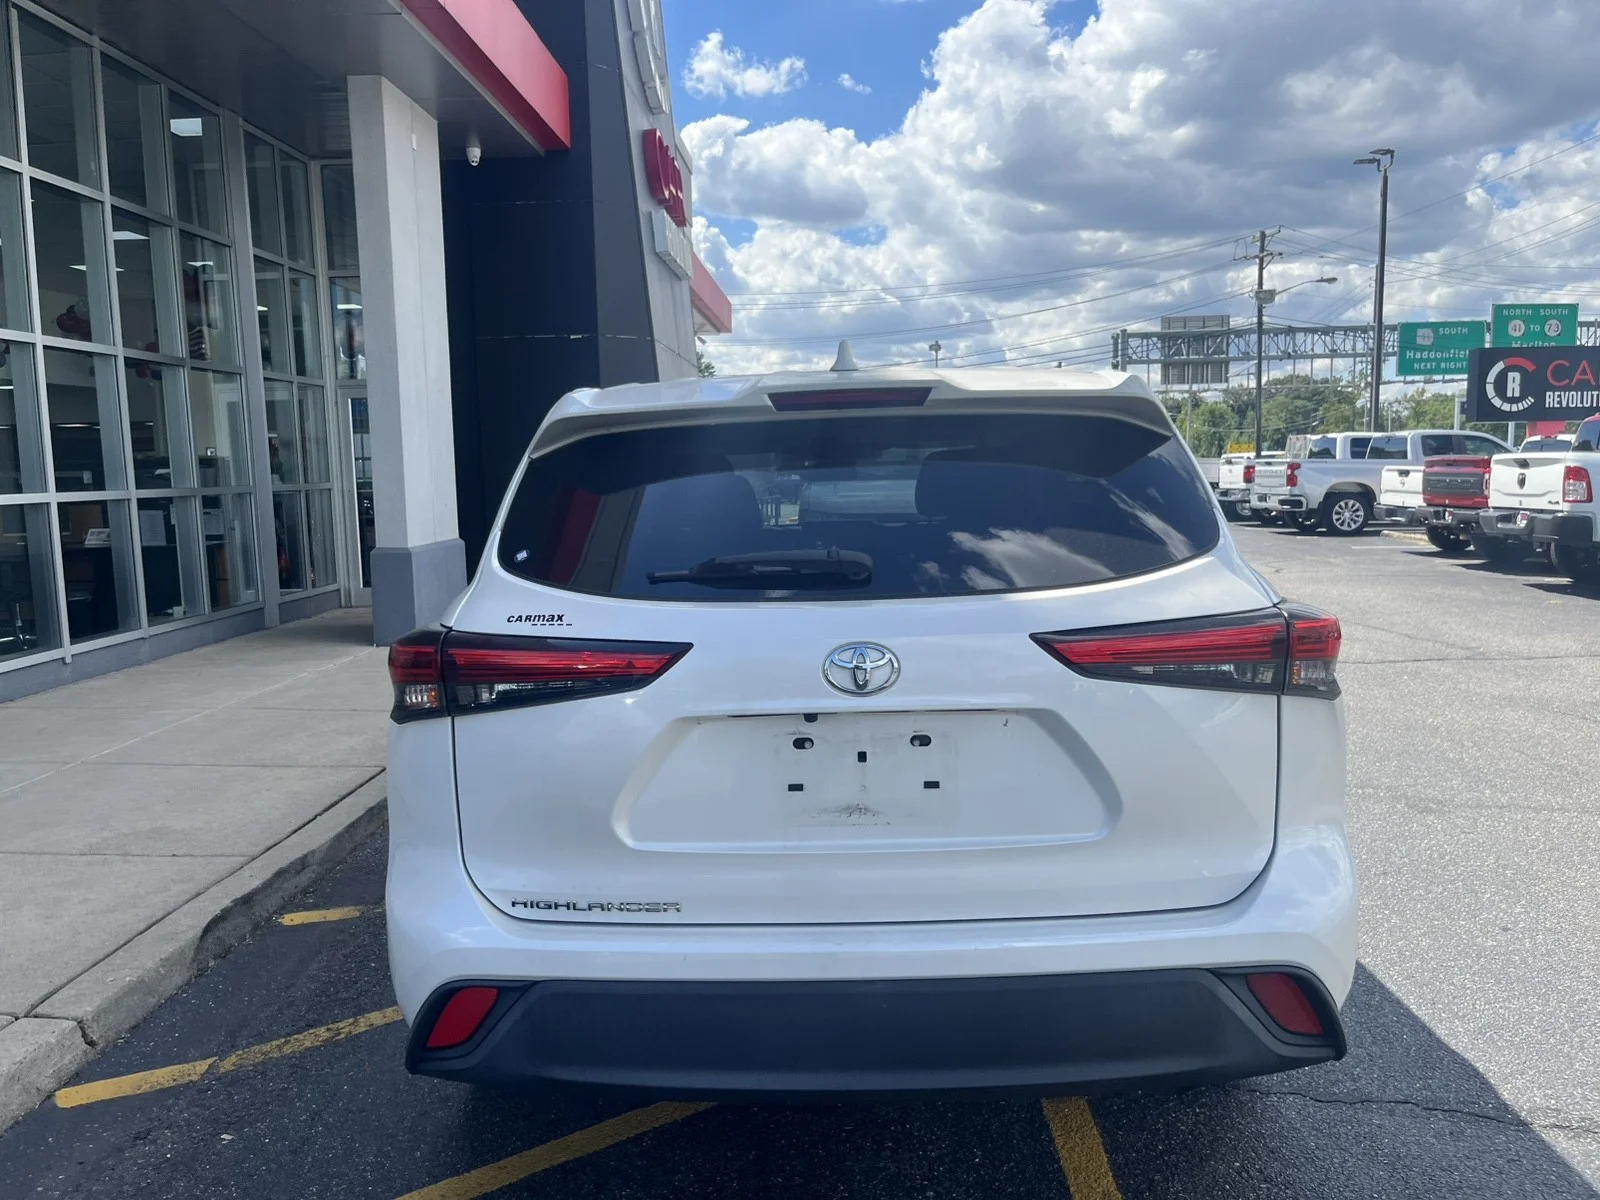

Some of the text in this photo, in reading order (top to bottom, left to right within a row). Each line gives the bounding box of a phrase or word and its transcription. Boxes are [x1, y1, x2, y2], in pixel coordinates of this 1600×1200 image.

[1511, 324, 1560, 333] 41 TO 73
[1547, 360, 1600, 386] CA
[512, 897, 681, 912] HIGHLANDER
